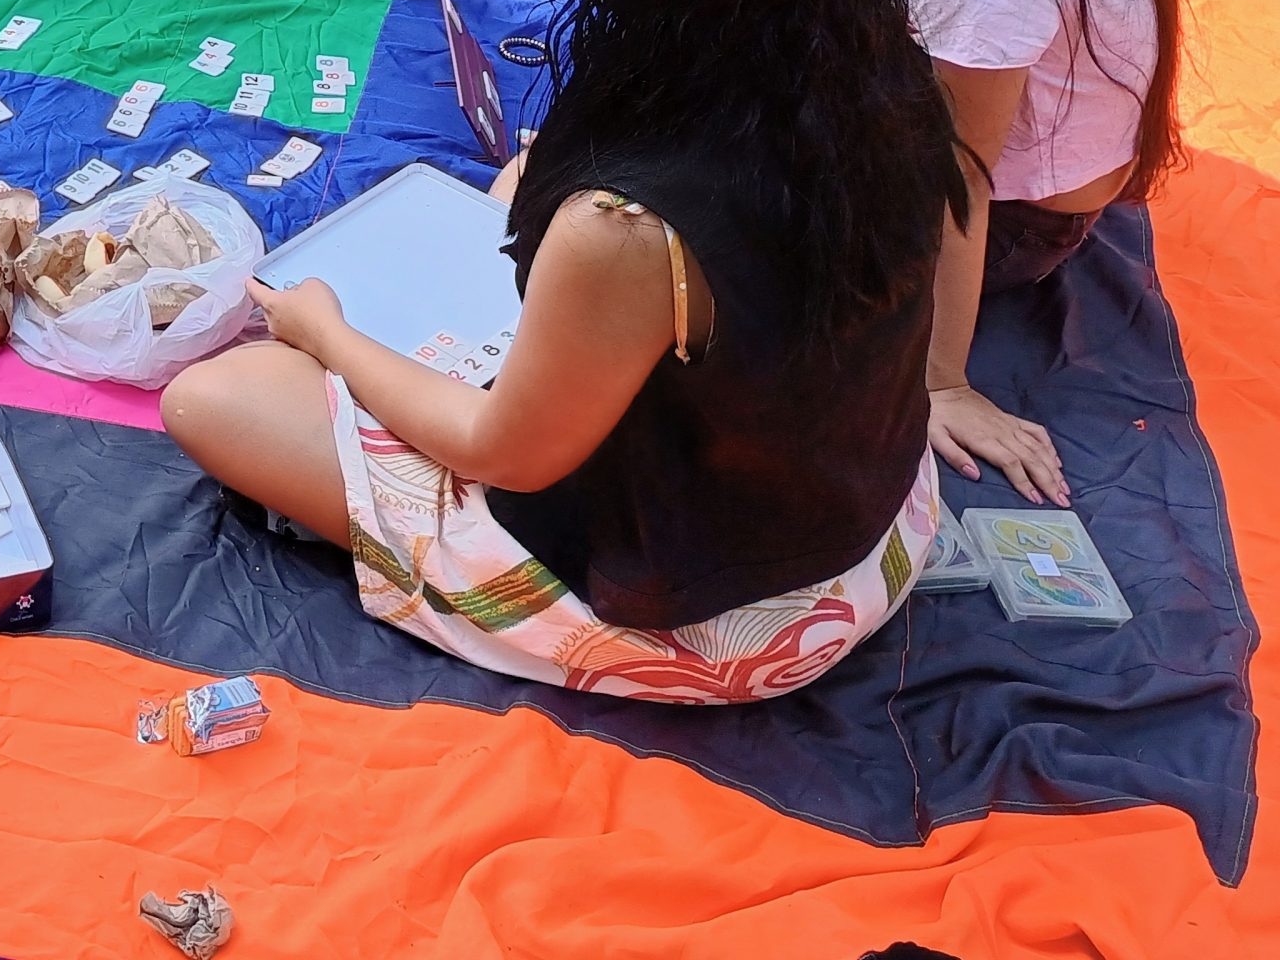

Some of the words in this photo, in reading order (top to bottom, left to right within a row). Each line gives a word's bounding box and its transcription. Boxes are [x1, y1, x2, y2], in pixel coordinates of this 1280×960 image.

[207, 40, 219, 48] 4
[205, 52, 217, 60] 4
[245, 75, 258, 86] 12
[124, 96, 138, 104] 6
[240, 91, 253, 99] 11
[233, 102, 248, 111] 10
[289, 141, 303, 152] 5
[165, 163, 179, 173] 2
[178, 152, 192, 162] 3
[64, 184, 77, 193] 9
[73, 173, 90, 184] 10
[87, 163, 104, 174] 11
[415, 345, 437, 361] 10
[436, 332, 454, 346] 5
[464, 358, 483, 371] 2
[482, 344, 500, 356] 8
